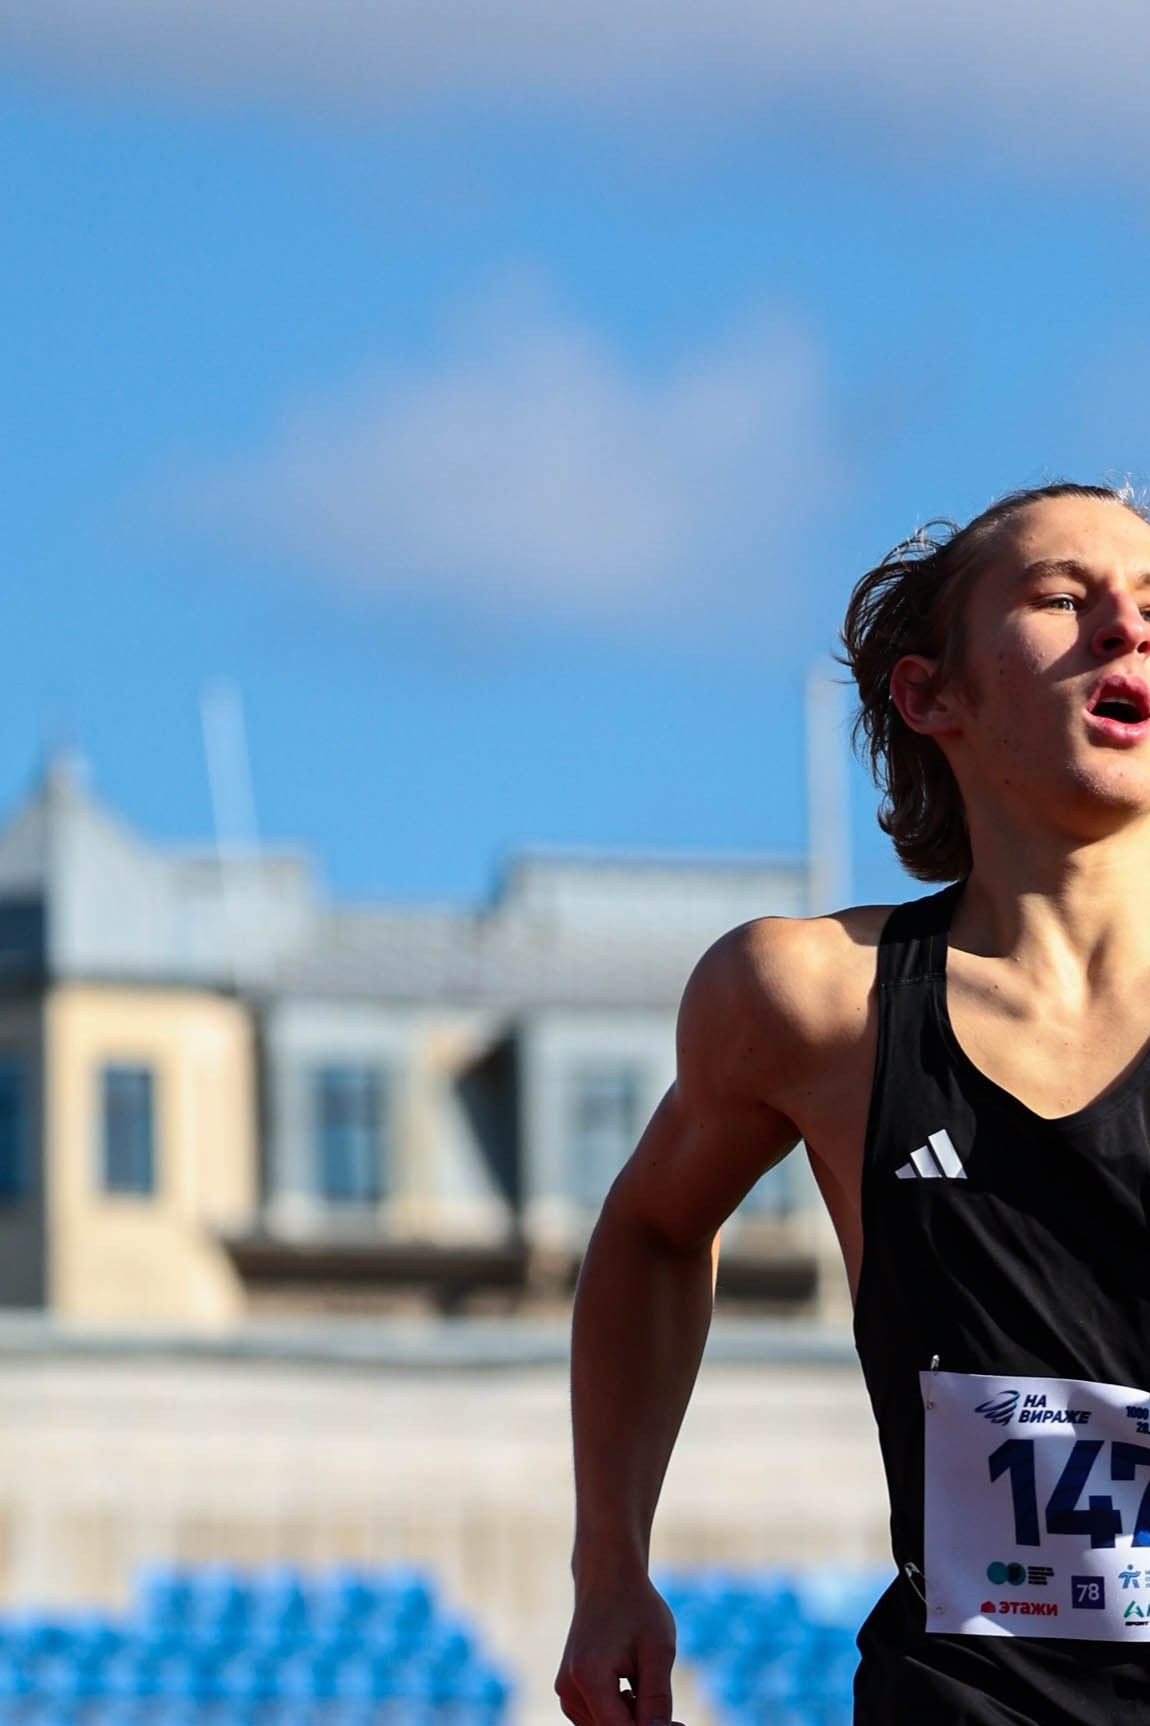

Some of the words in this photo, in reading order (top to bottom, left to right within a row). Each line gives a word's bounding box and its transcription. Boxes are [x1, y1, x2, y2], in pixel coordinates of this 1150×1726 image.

[1023, 1394, 1047, 1408] НА
[1018, 1410, 1092, 1425] ВИРАЖЕ
[1076, 1582, 1100, 1603] 78
